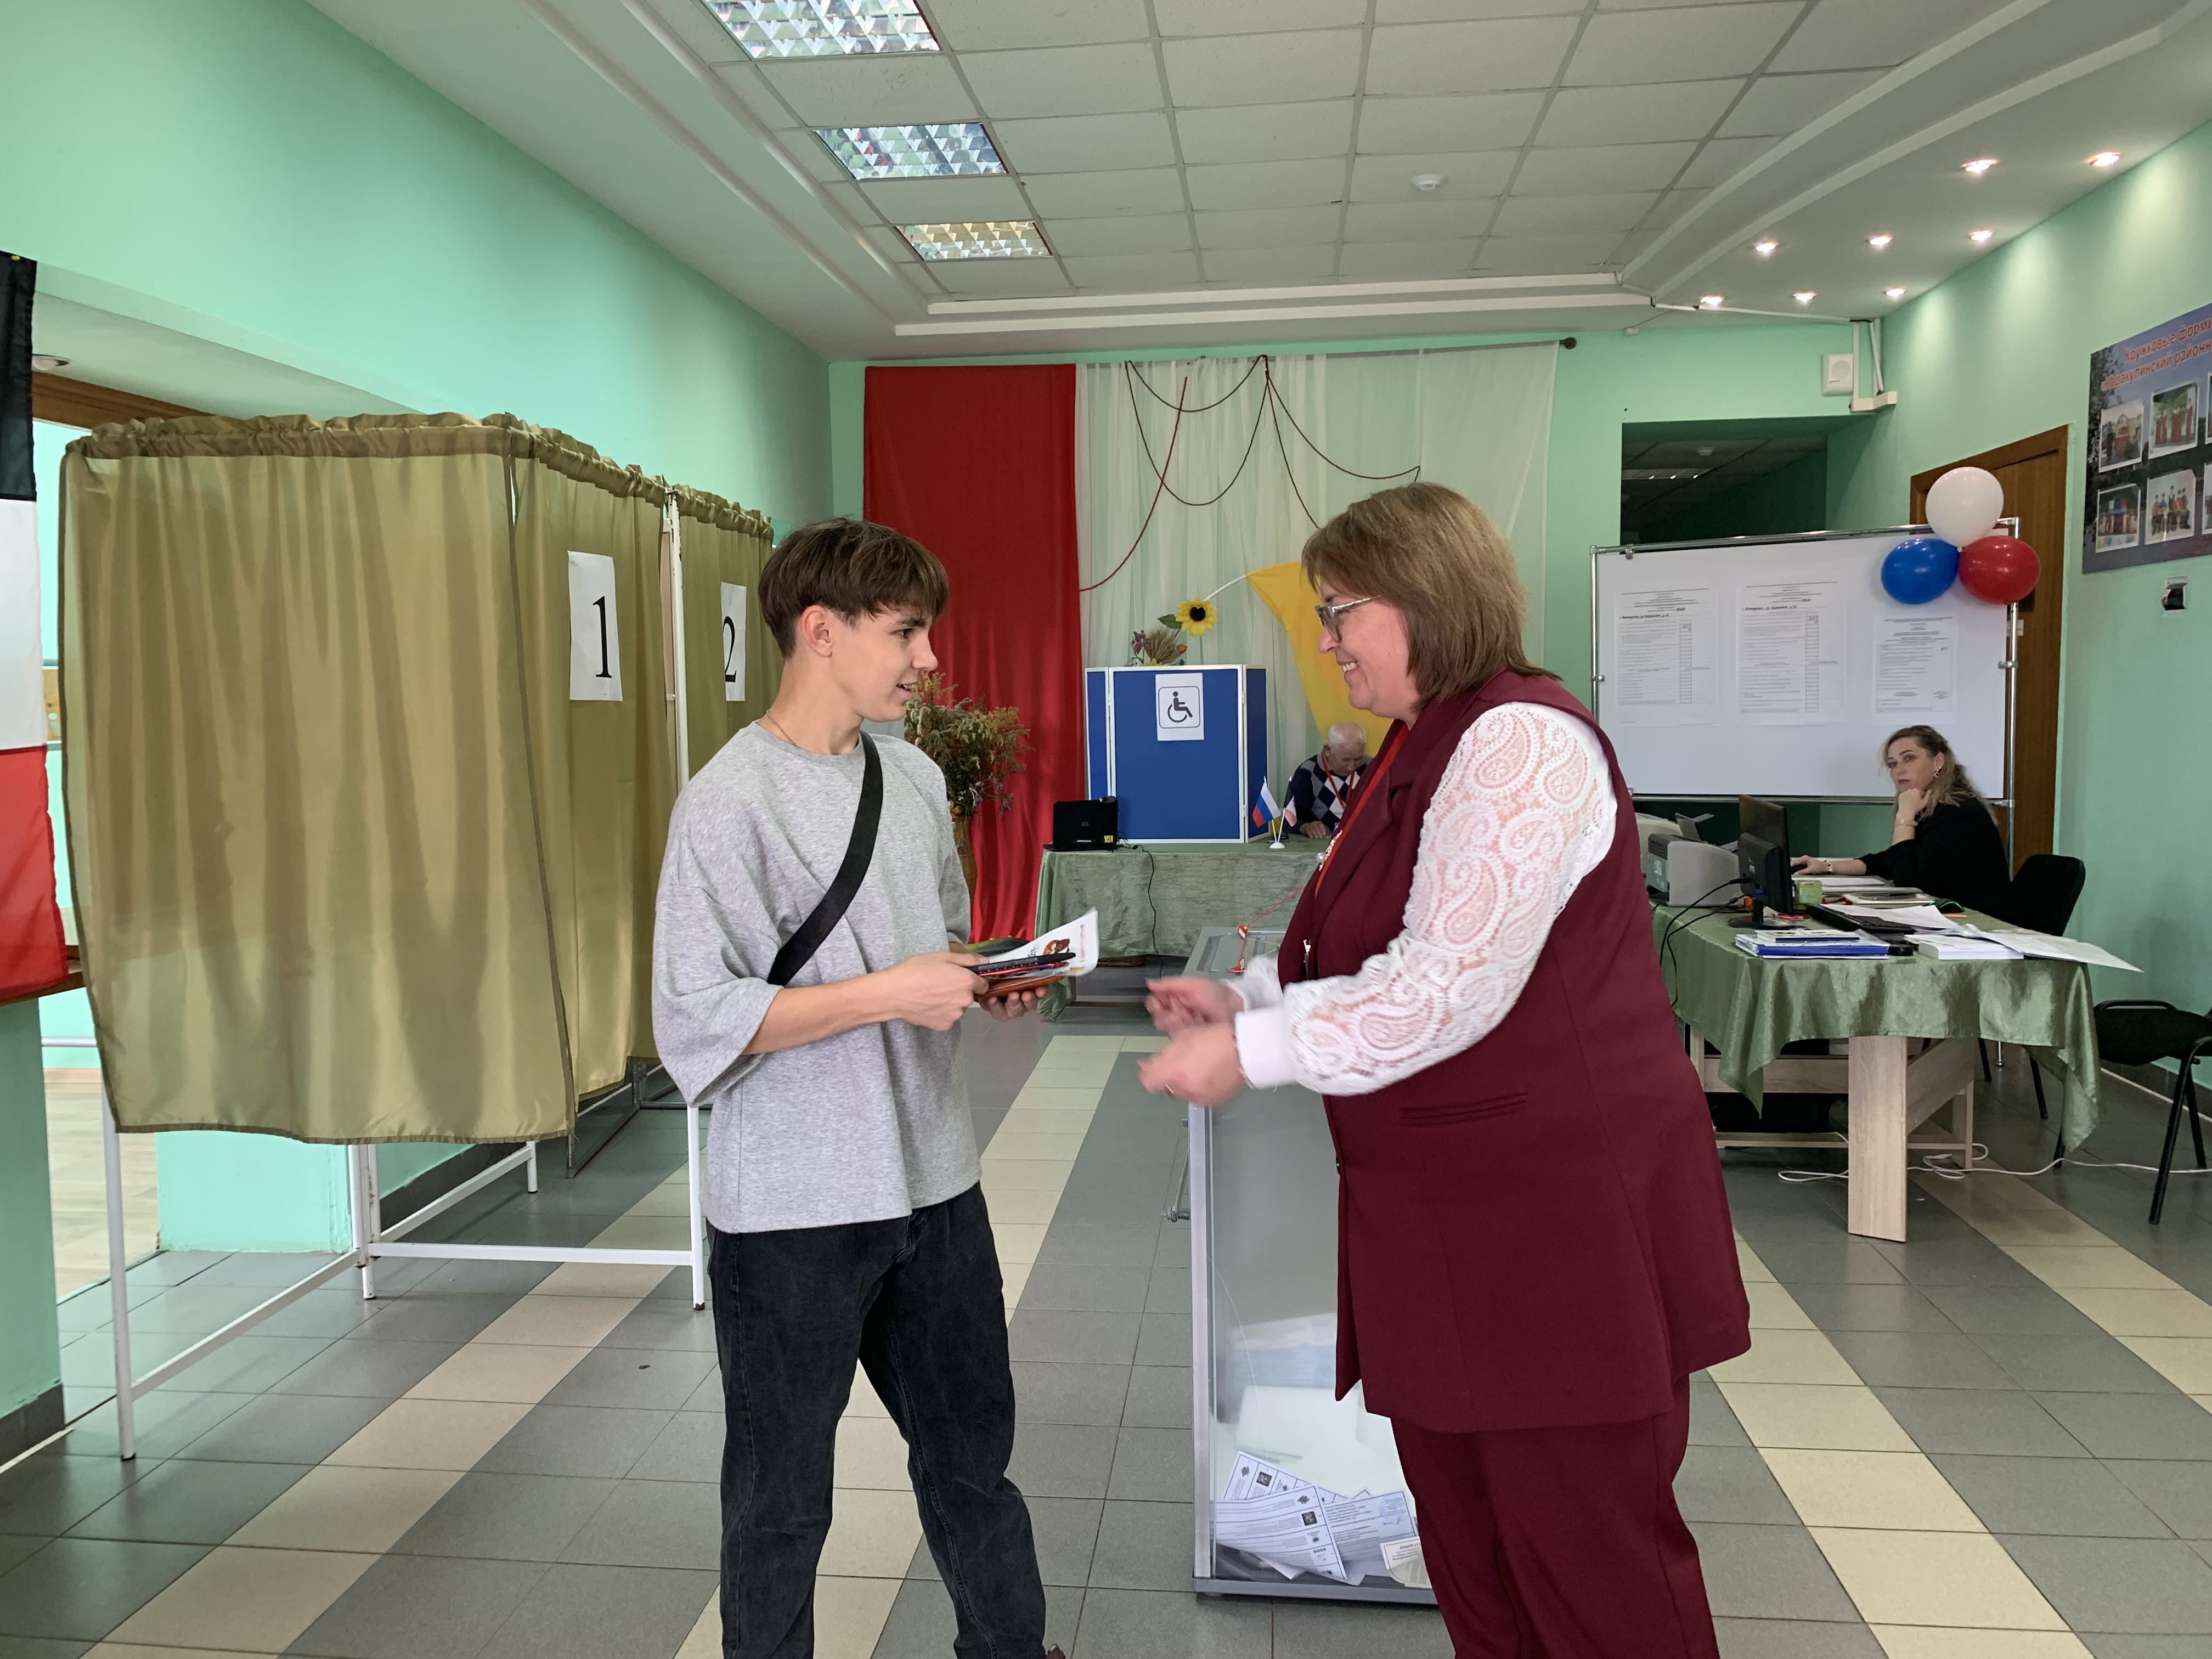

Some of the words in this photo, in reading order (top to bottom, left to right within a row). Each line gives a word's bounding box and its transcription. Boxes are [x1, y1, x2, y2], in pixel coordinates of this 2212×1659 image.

[2125, 334, 2175, 362] Кружковые
[593, 596, 612, 678] 1
[723, 616, 736, 682] 2
